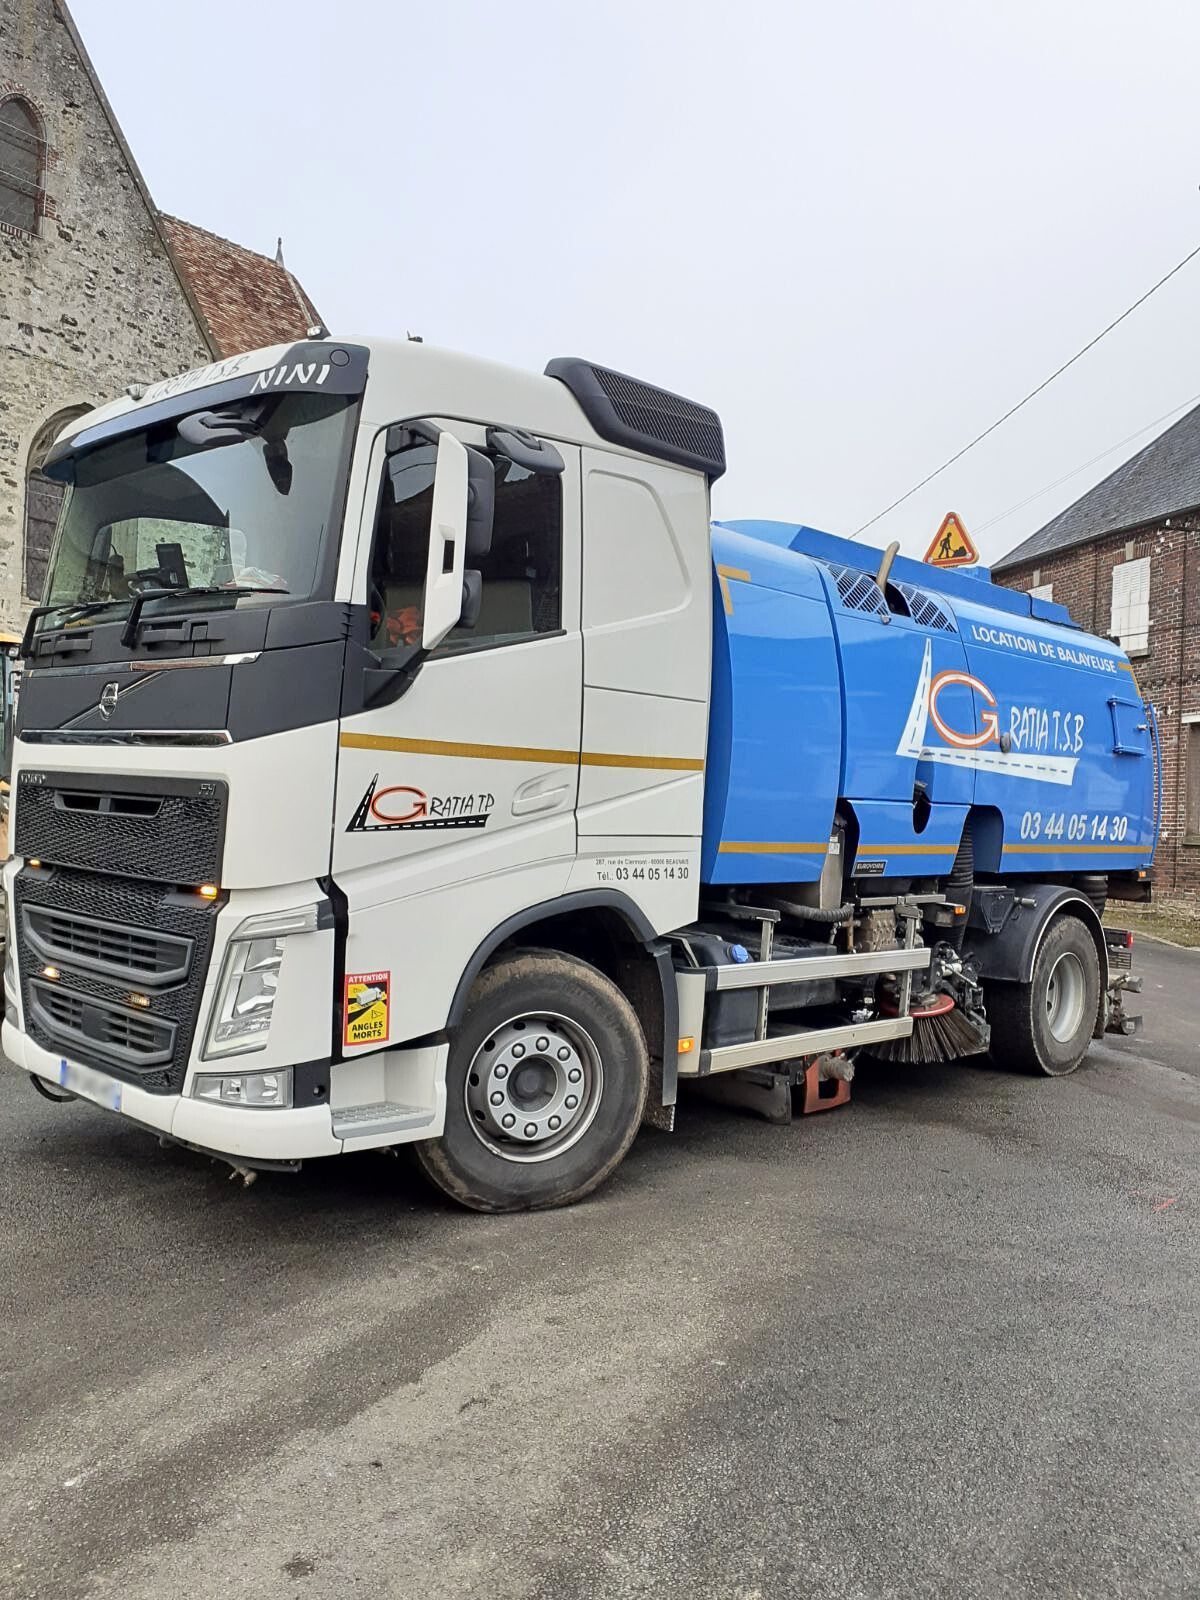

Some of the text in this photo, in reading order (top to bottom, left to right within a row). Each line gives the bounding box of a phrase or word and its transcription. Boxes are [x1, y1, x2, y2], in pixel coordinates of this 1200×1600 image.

[250, 363, 331, 393] NINI
[971, 625, 1117, 673] LOCATION DE BALAYEUSE
[1020, 811, 1128, 841] 03 44 05 14 30
[615, 867, 629, 880] 03
[632, 867, 645, 880] 44
[648, 867, 660, 880] 05
[663, 867, 675, 879] 14
[677, 867, 689, 879] 30
[348, 974, 388, 983] ATTENTION
[352, 1021, 383, 1031] ANGLES
[353, 1029, 382, 1040] MORTS
